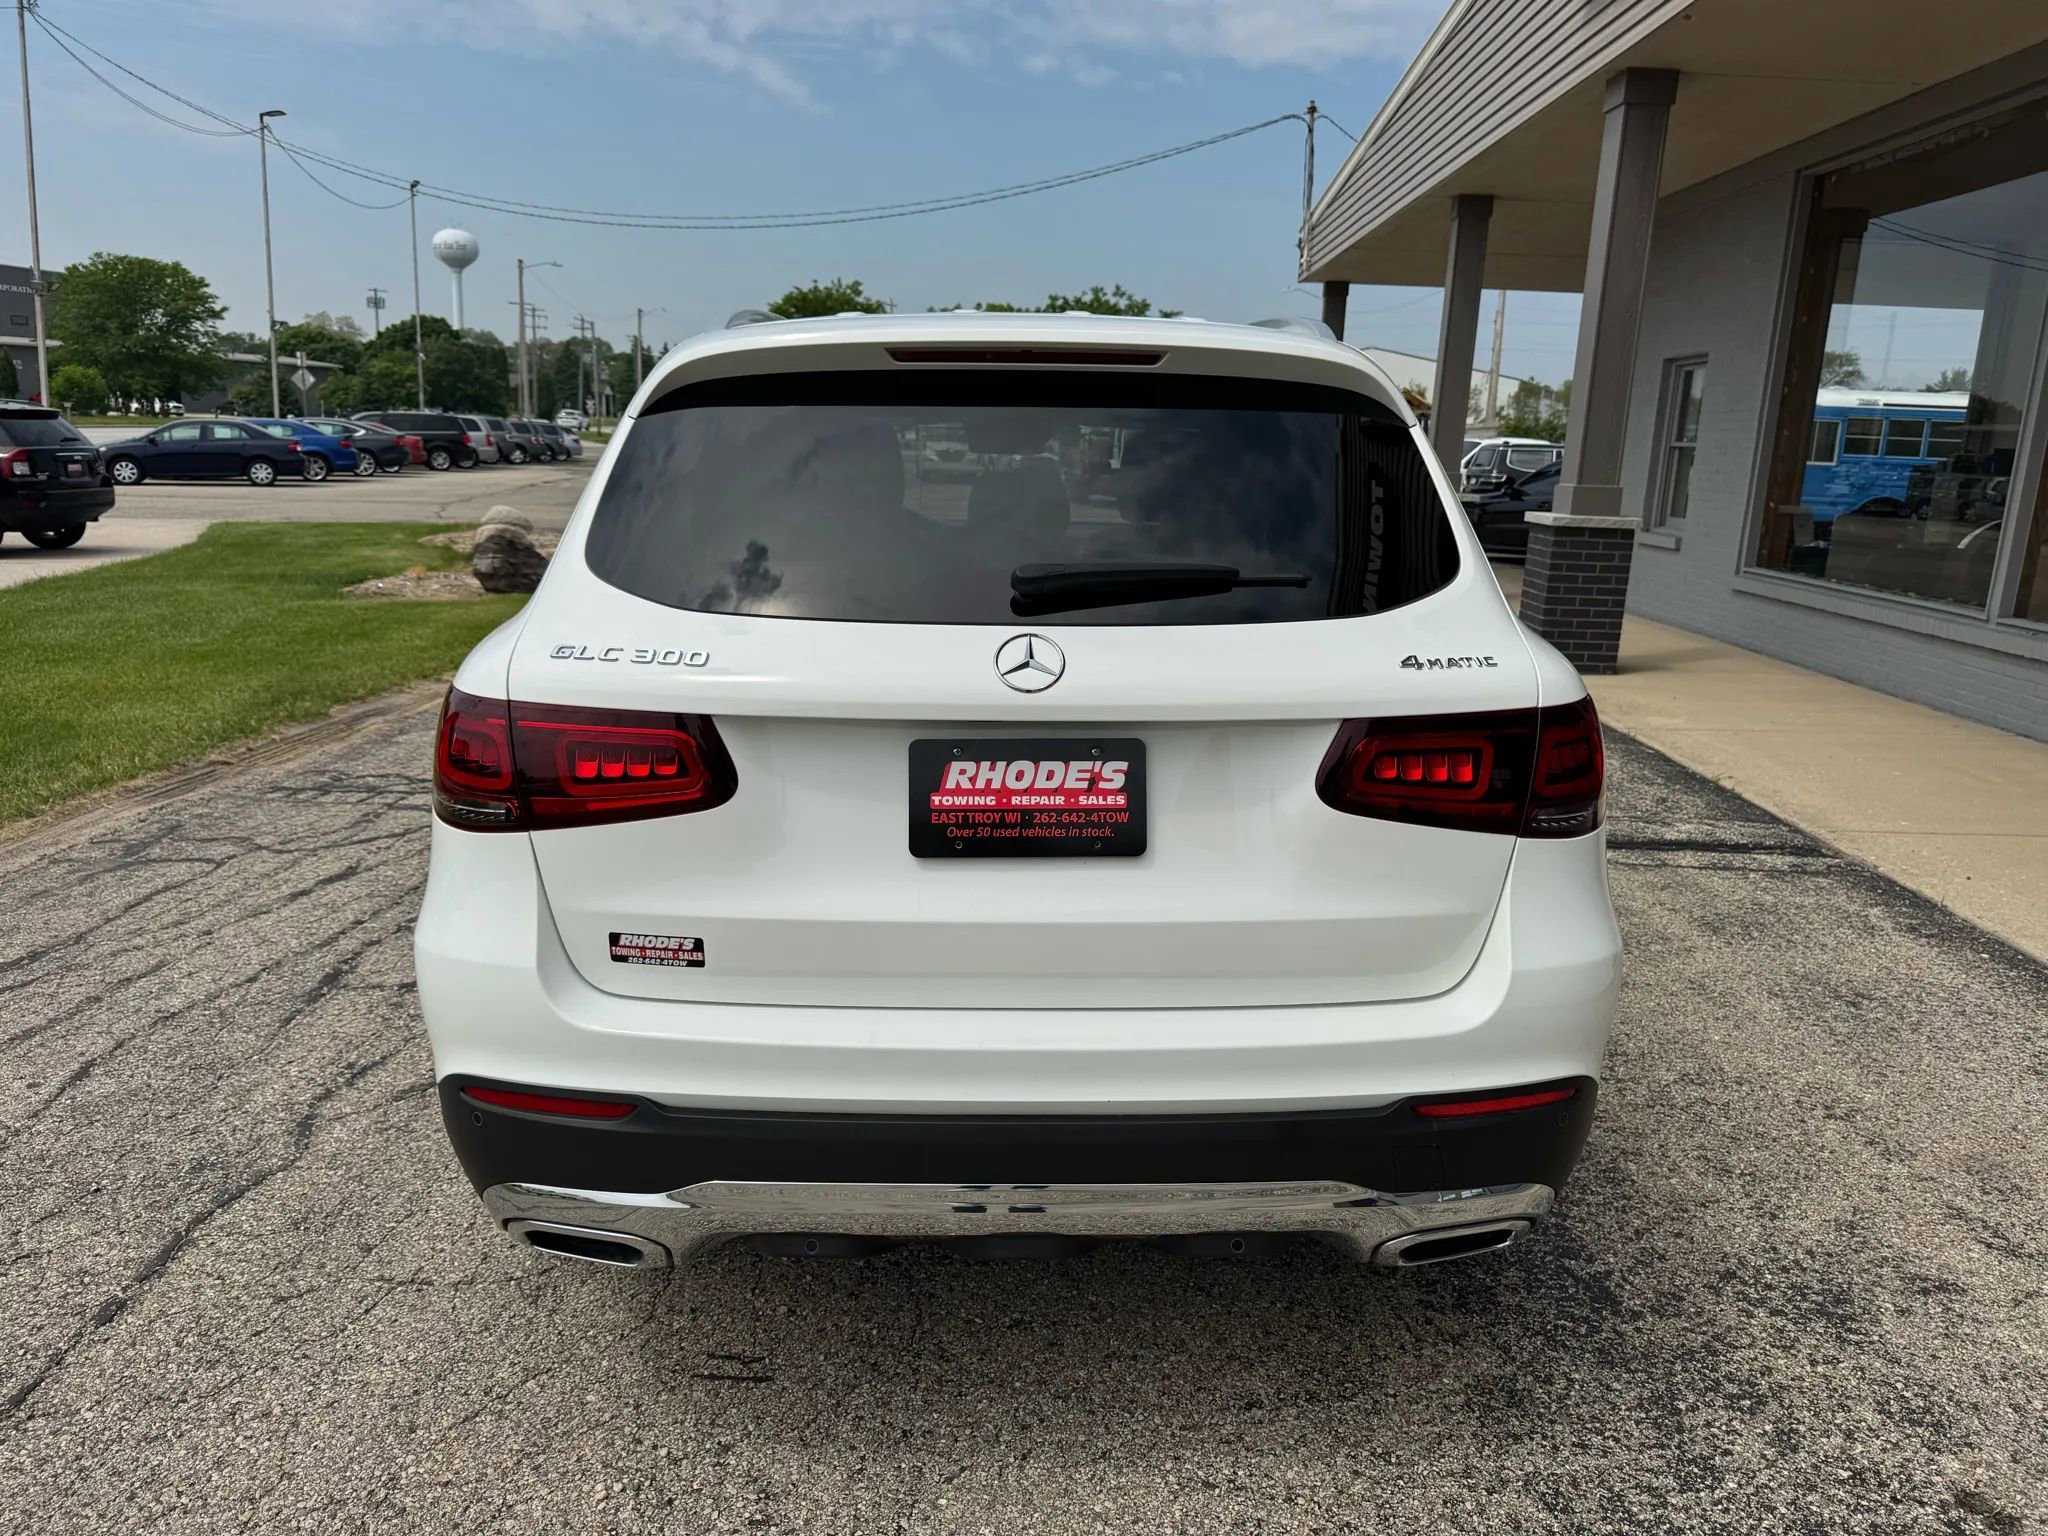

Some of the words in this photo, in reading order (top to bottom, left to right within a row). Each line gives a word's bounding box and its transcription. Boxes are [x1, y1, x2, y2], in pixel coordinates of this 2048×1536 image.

[550, 644, 624, 662] GLC
[630, 648, 710, 668] 300
[1399, 654, 1498, 670] 4MATIC
[944, 760, 1129, 790] RHODE'S
[932, 795, 996, 806] TOWING
[1011, 795, 1065, 805] REPAIR
[1078, 795, 1125, 805] SALES
[931, 812, 966, 824] EAST
[967, 812, 1002, 824] TROY
[1004, 812, 1021, 823] WI
[1033, 811, 1130, 823] 262-642-4TOW
[946, 827, 974, 837] Over
[977, 827, 990, 837] 50
[993, 827, 1019, 837] used
[1022, 826, 1066, 837] vehicles
[1069, 827, 1079, 837] in
[1082, 826, 1115, 837] stock.
[618, 934, 695, 950] RHODE'S
[611, 946, 641, 957] TOWING
[646, 949, 673, 960] REPAIR
[678, 951, 704, 961] SALES
[628, 957, 687, 967] 262-642-4TOW
